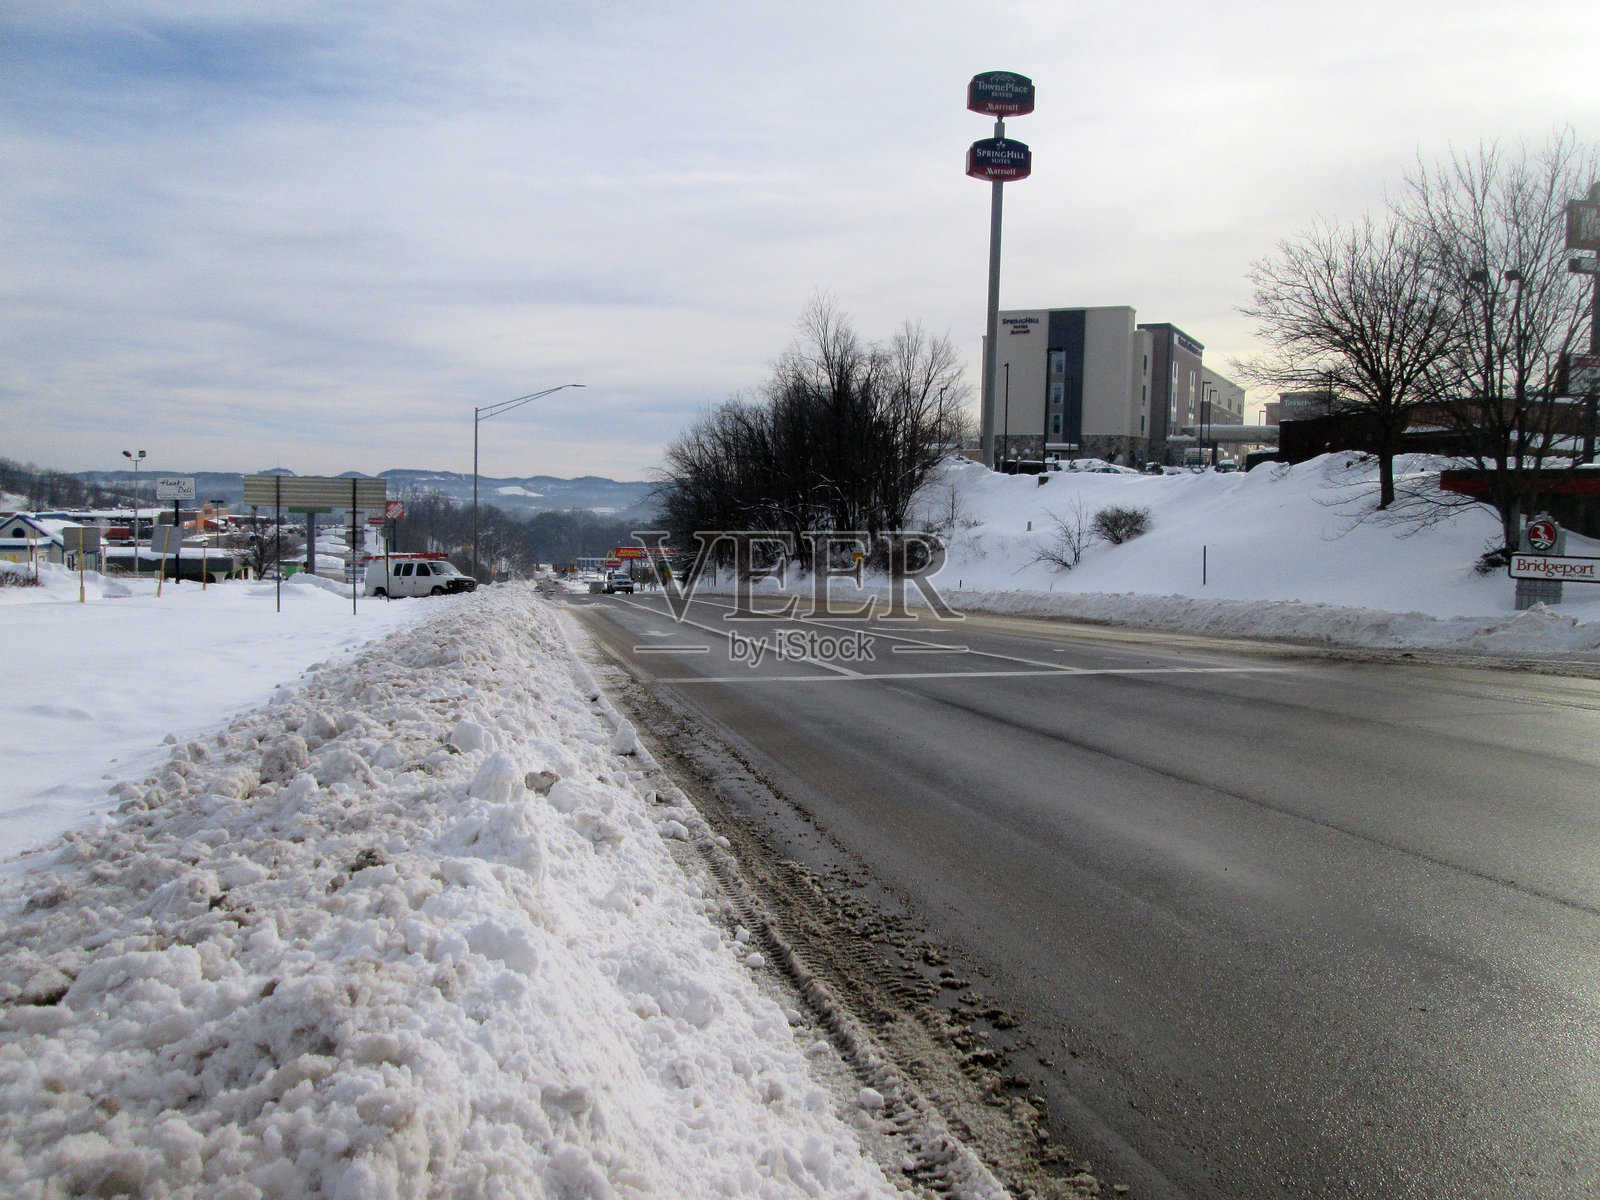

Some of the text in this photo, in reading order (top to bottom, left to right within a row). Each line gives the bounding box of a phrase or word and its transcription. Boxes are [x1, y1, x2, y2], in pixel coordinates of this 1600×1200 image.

[976, 81, 1029, 93] TownePlace
[985, 102, 1018, 111] Marriott
[985, 167, 1016, 176] Marriott
[1515, 558, 1595, 577] Bridgeport
